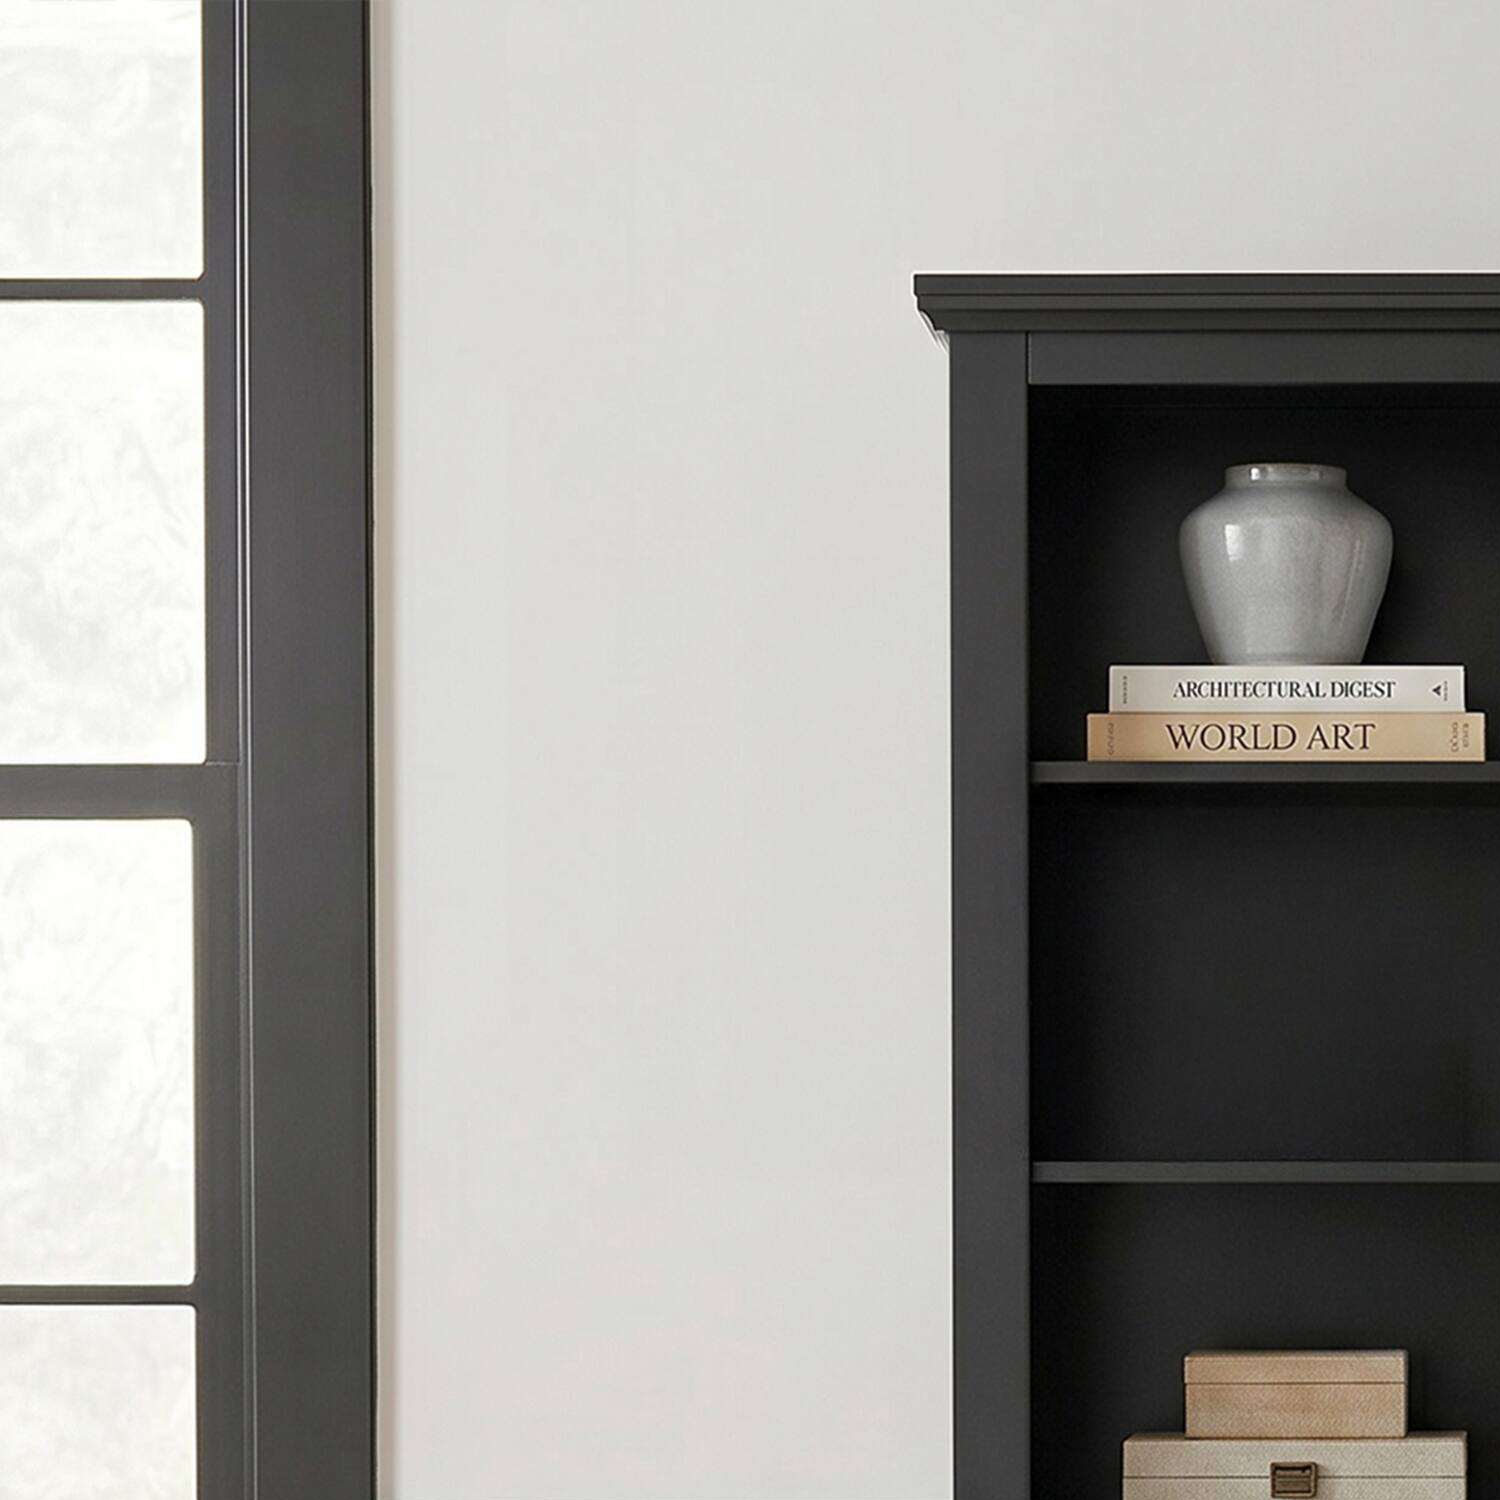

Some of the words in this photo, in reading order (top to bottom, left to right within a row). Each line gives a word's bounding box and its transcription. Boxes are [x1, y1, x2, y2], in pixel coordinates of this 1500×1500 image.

[1173, 681, 1326, 698] ARCHITECTURAL
[1330, 680, 1396, 698] DIGEST
[1165, 723, 1297, 751] WORLD
[1306, 723, 1376, 751] ART
